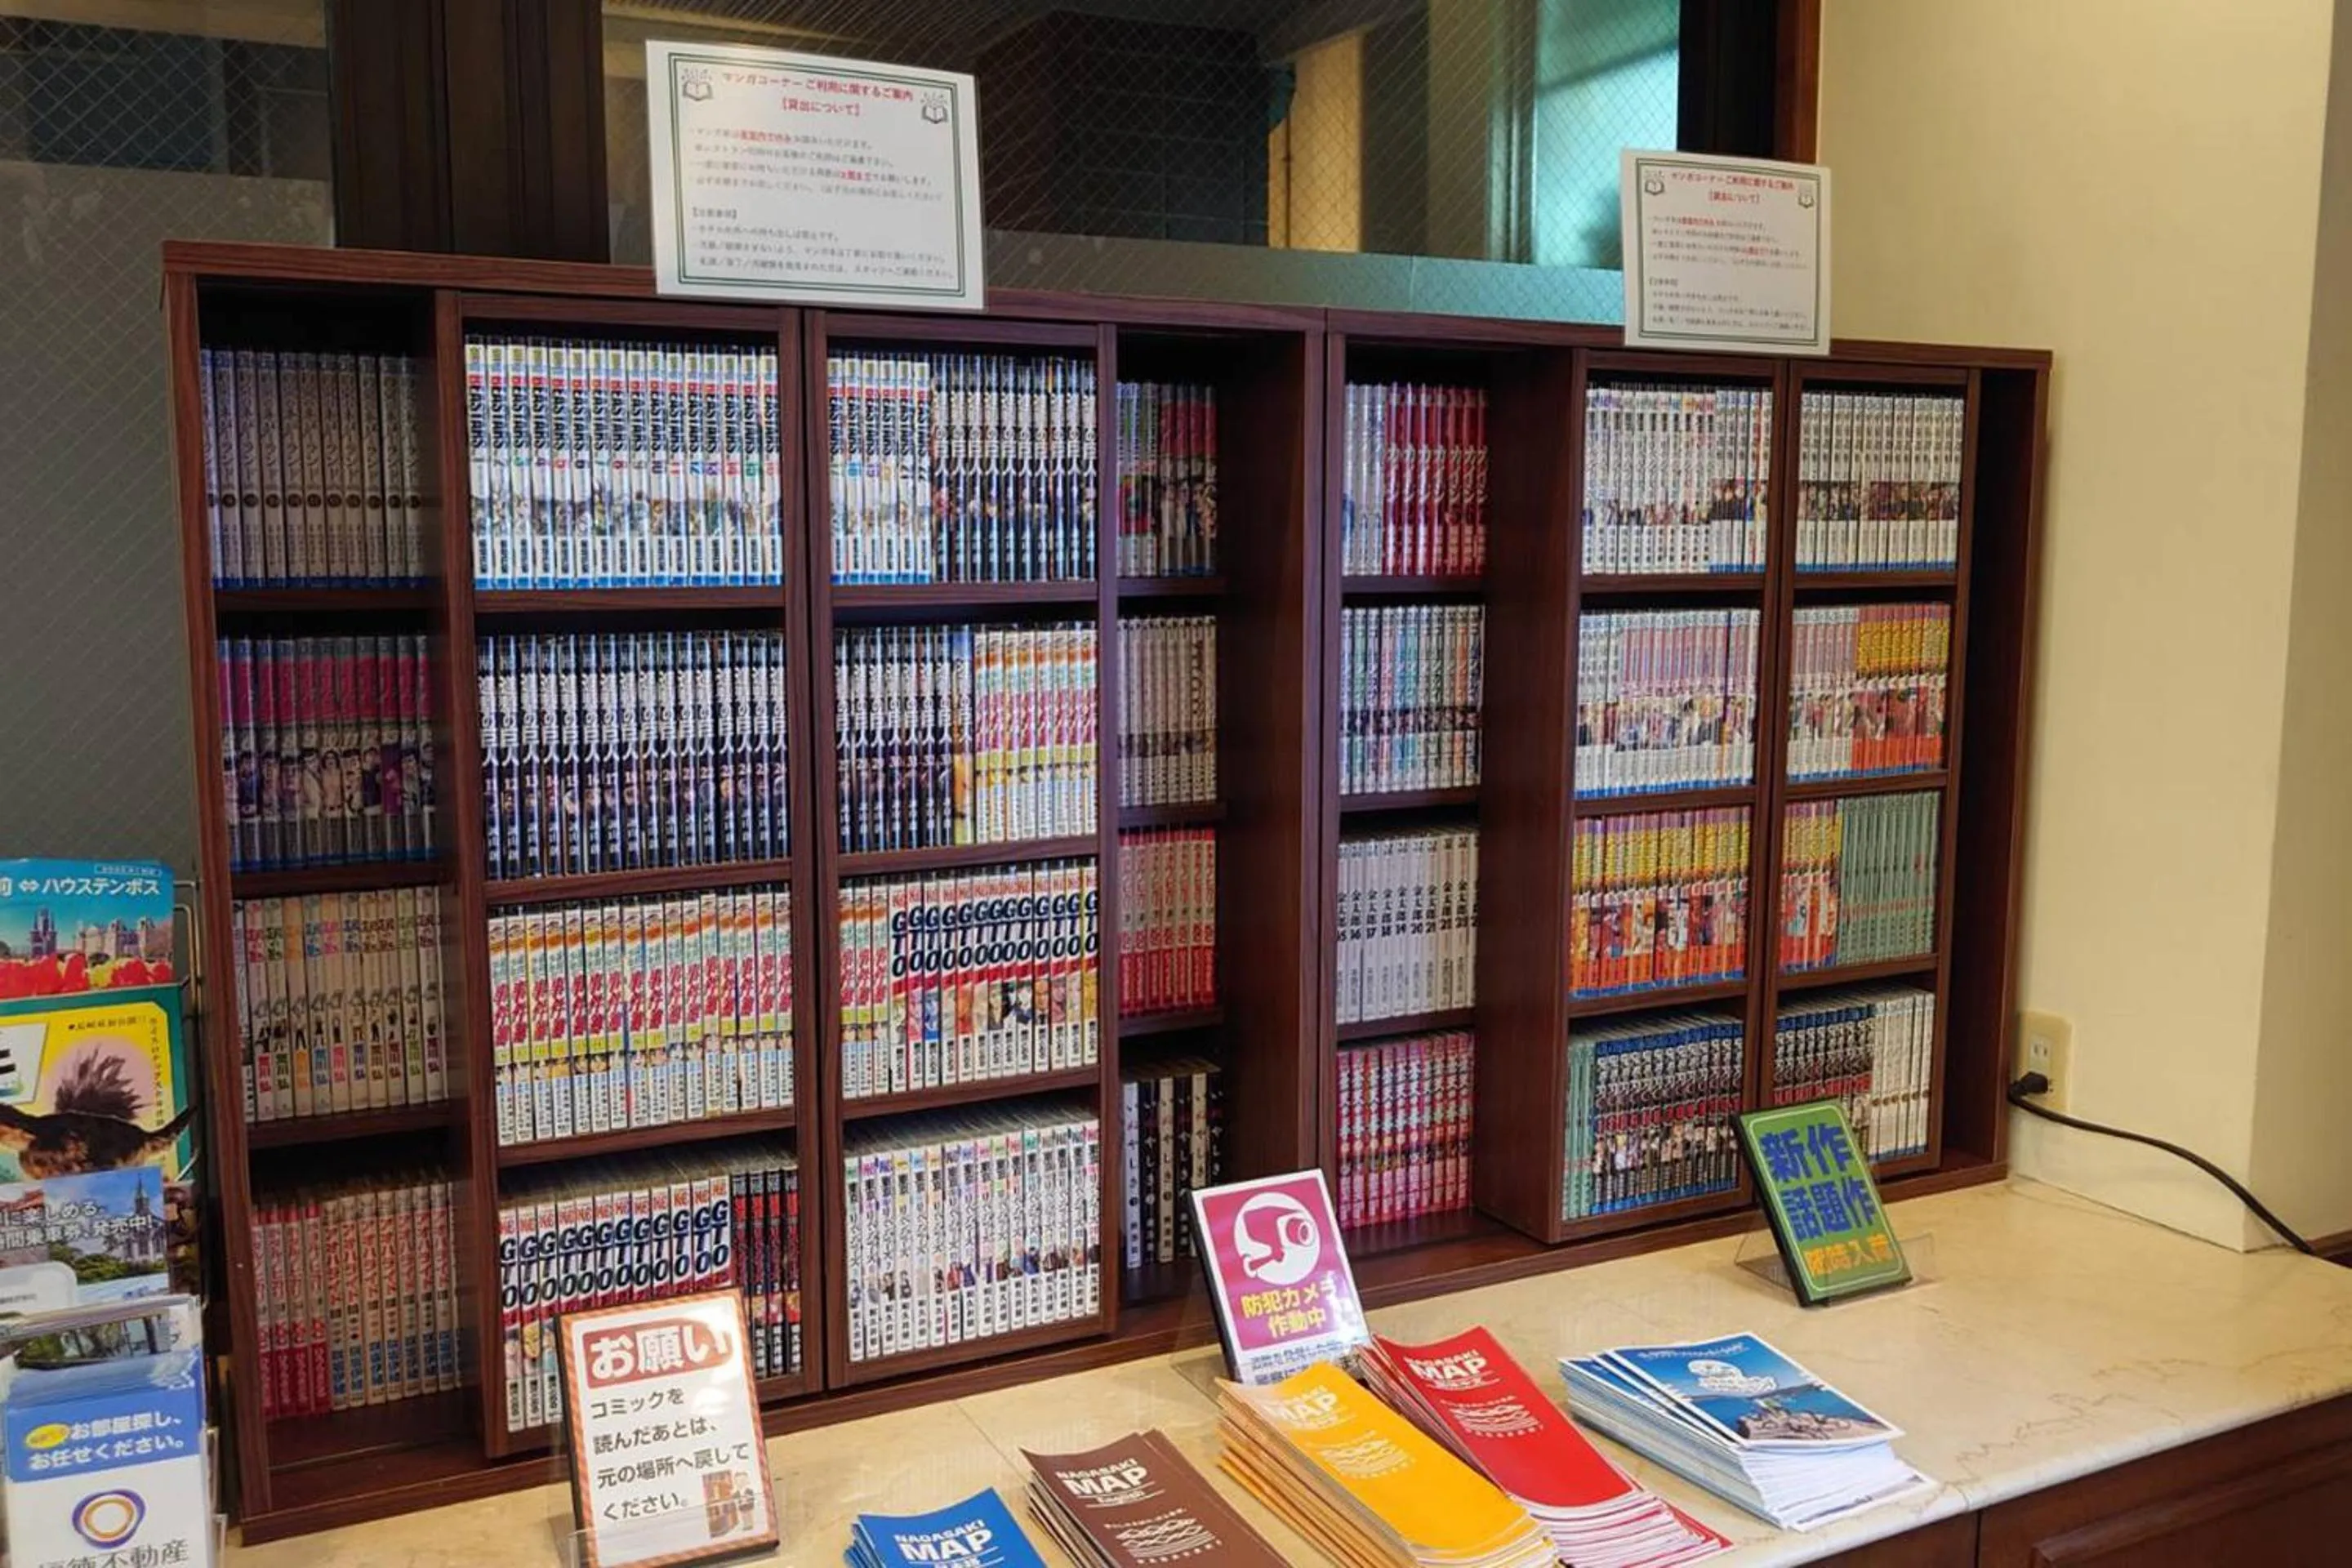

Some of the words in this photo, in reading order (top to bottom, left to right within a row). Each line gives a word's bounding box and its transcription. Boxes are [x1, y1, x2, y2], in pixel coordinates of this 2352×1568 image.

[42, 876, 161, 896] ハウステンボス
[892, 911, 906, 977] GTO
[909, 906, 923, 972] GTO
[925, 906, 939, 972] GTO
[942, 906, 956, 970] GTO
[959, 903, 973, 968] GTO
[974, 900, 987, 965] GTO
[988, 898, 1002, 964] GTO
[1003, 898, 1016, 962] GTO
[1017, 897, 1031, 960] GTO
[1035, 897, 1049, 959] GTO
[1052, 894, 1065, 957] GTO
[1067, 893, 1080, 956] GTO
[1085, 891, 1098, 952] GTO
[1759, 1122, 1853, 1183] 新作
[695, 1207, 710, 1273] GTO
[712, 1200, 728, 1267] GTO
[1780, 1175, 1877, 1242] 話題作
[501, 1238, 516, 1307] GTO
[520, 1236, 537, 1305] GTO
[538, 1232, 556, 1301] GTO
[560, 1227, 577, 1296] GTO
[577, 1226, 595, 1294] GTO
[597, 1223, 612, 1290] GTO
[616, 1218, 631, 1286] GTO
[634, 1218, 650, 1286] GTO
[653, 1214, 669, 1282] GTO
[674, 1210, 690, 1276] GTO
[1240, 1270, 1339, 1319] 防犯カメラ
[1267, 1308, 1326, 1339] 作動中
[589, 1325, 734, 1380] お願い
[1409, 1356, 1487, 1380] MAP
[590, 1388, 685, 1420] コミックを
[593, 1417, 718, 1455] 読んだあとは、
[29, 1435, 185, 1471] お任せください。
[595, 1442, 751, 1490] 元の場所へ戻して
[1054, 1457, 1139, 1480] NAGASAKI
[1062, 1466, 1148, 1495] MAP
[602, 1491, 689, 1521] ください。
[893, 1518, 986, 1543] NAGASAKI
[898, 1528, 994, 1561] MAP
